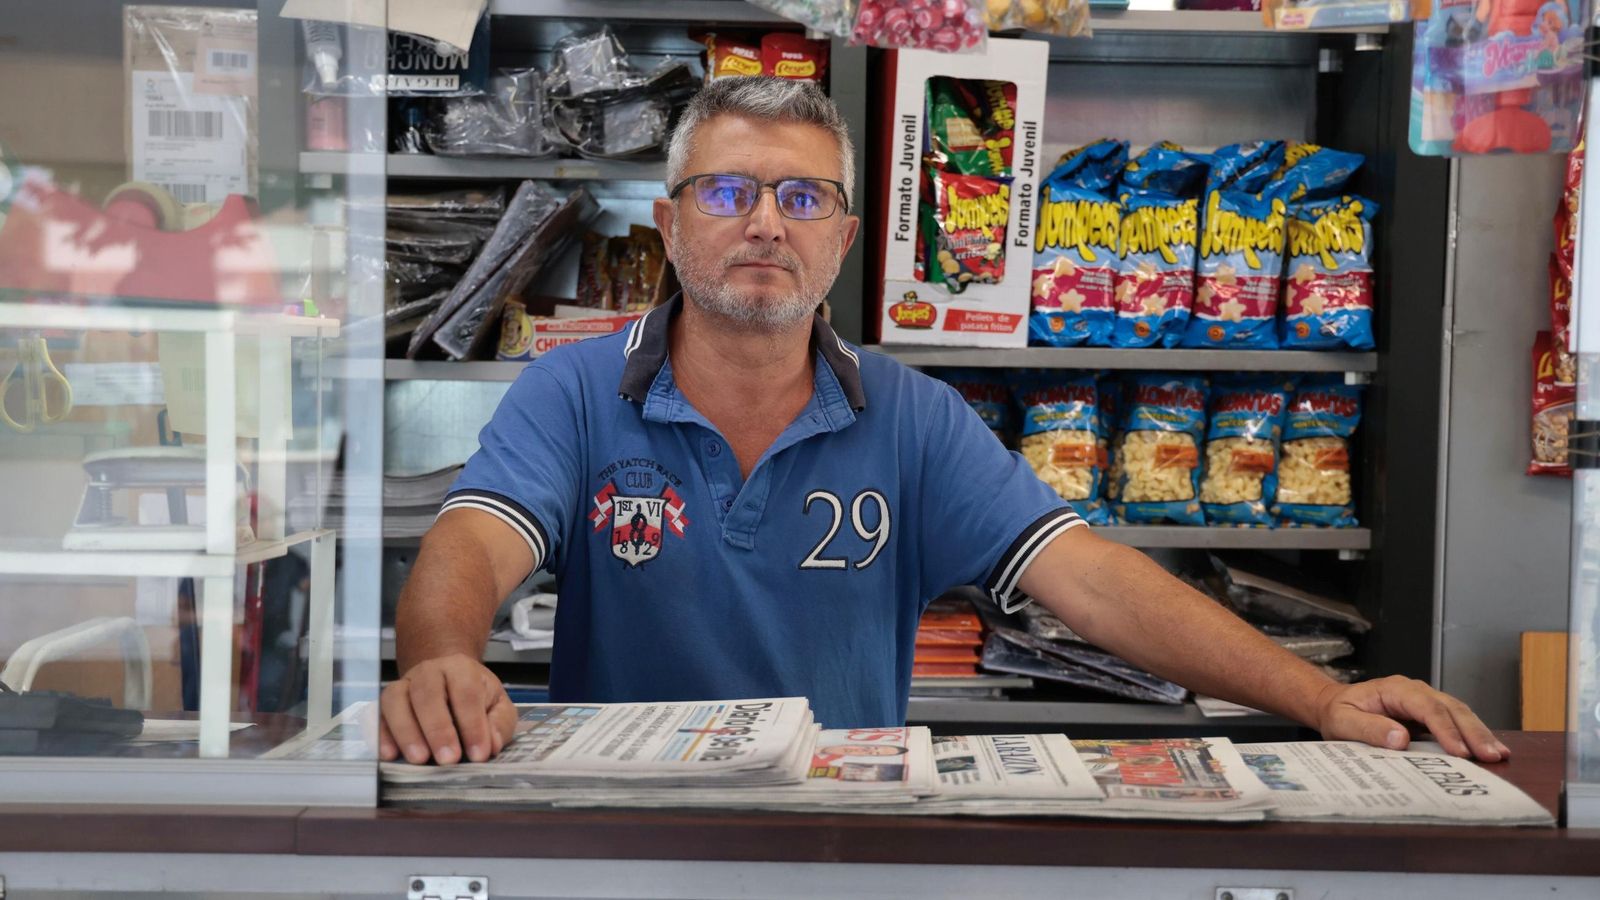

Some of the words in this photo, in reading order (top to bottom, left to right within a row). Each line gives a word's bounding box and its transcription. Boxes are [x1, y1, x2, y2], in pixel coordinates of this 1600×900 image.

[364, 52, 469, 70] MONCHO
[899, 115, 917, 172] Juvenil
[1020, 121, 1037, 178] Juvenil
[895, 177, 913, 242] Formato
[1014, 183, 1033, 248] Formato
[1201, 190, 1286, 270] Jumpers
[960, 322, 989, 331] patata
[998, 315, 1010, 323] de
[598, 462, 618, 480] THE
[617, 458, 656, 470] YATCH
[625, 472, 653, 489] CLUB
[646, 501, 661, 517] VI
[799, 488, 892, 571] 29
[724, 702, 773, 725] Diario
[991, 736, 1027, 747] LA
[1402, 756, 1454, 769] EL
